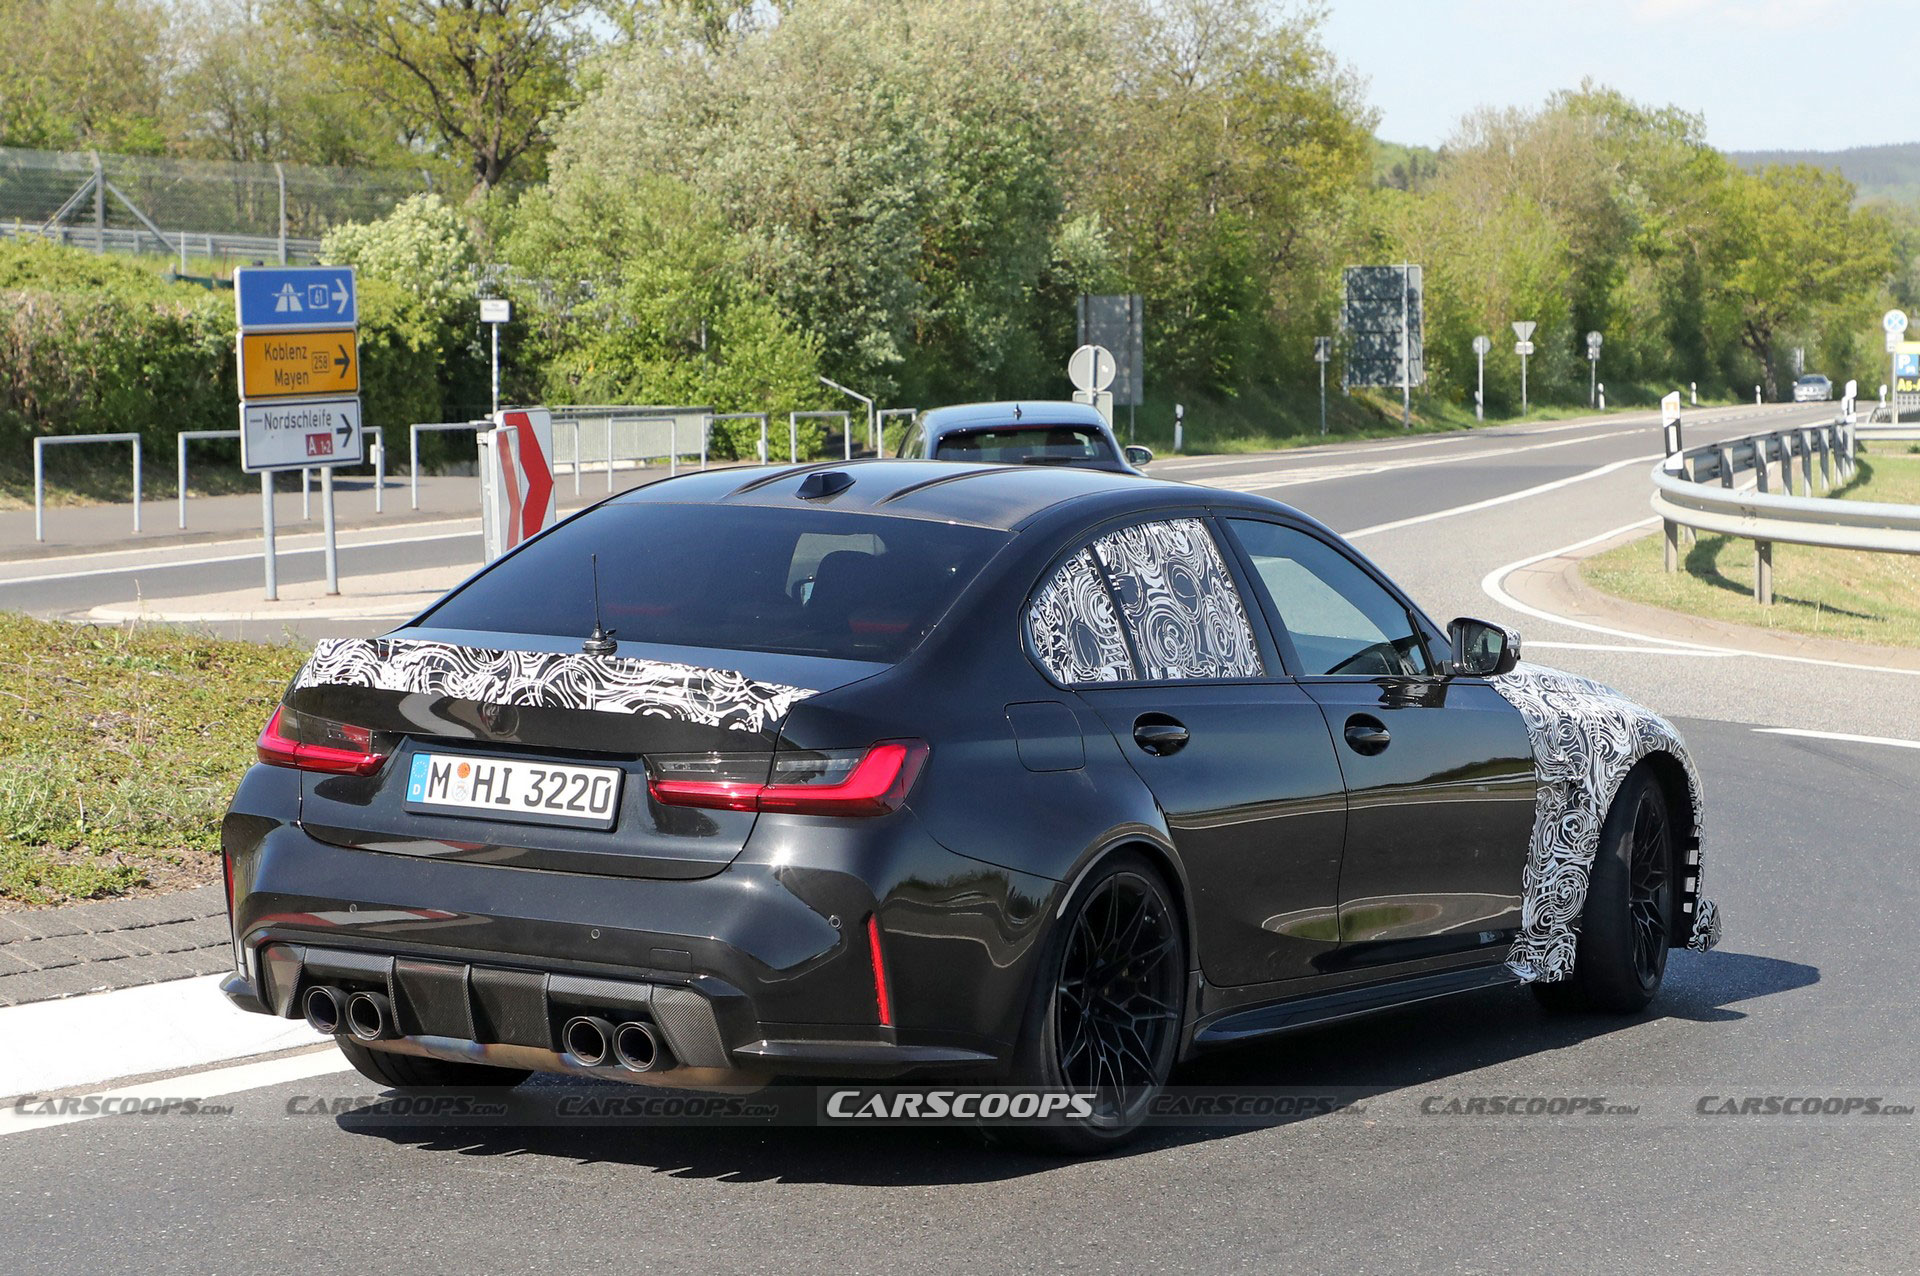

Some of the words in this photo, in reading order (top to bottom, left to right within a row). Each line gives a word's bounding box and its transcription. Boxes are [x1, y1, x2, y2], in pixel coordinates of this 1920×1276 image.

[314, 289, 323, 304] 61
[264, 343, 308, 361] Koblenz
[313, 355, 328, 370] 258
[274, 369, 309, 390] Mayen
[264, 410, 332, 430] Nordschleife
[308, 436, 317, 454] A
[412, 783, 420, 796] D
[428, 761, 452, 799] M
[471, 764, 512, 805] HI
[523, 769, 612, 814] 3220
